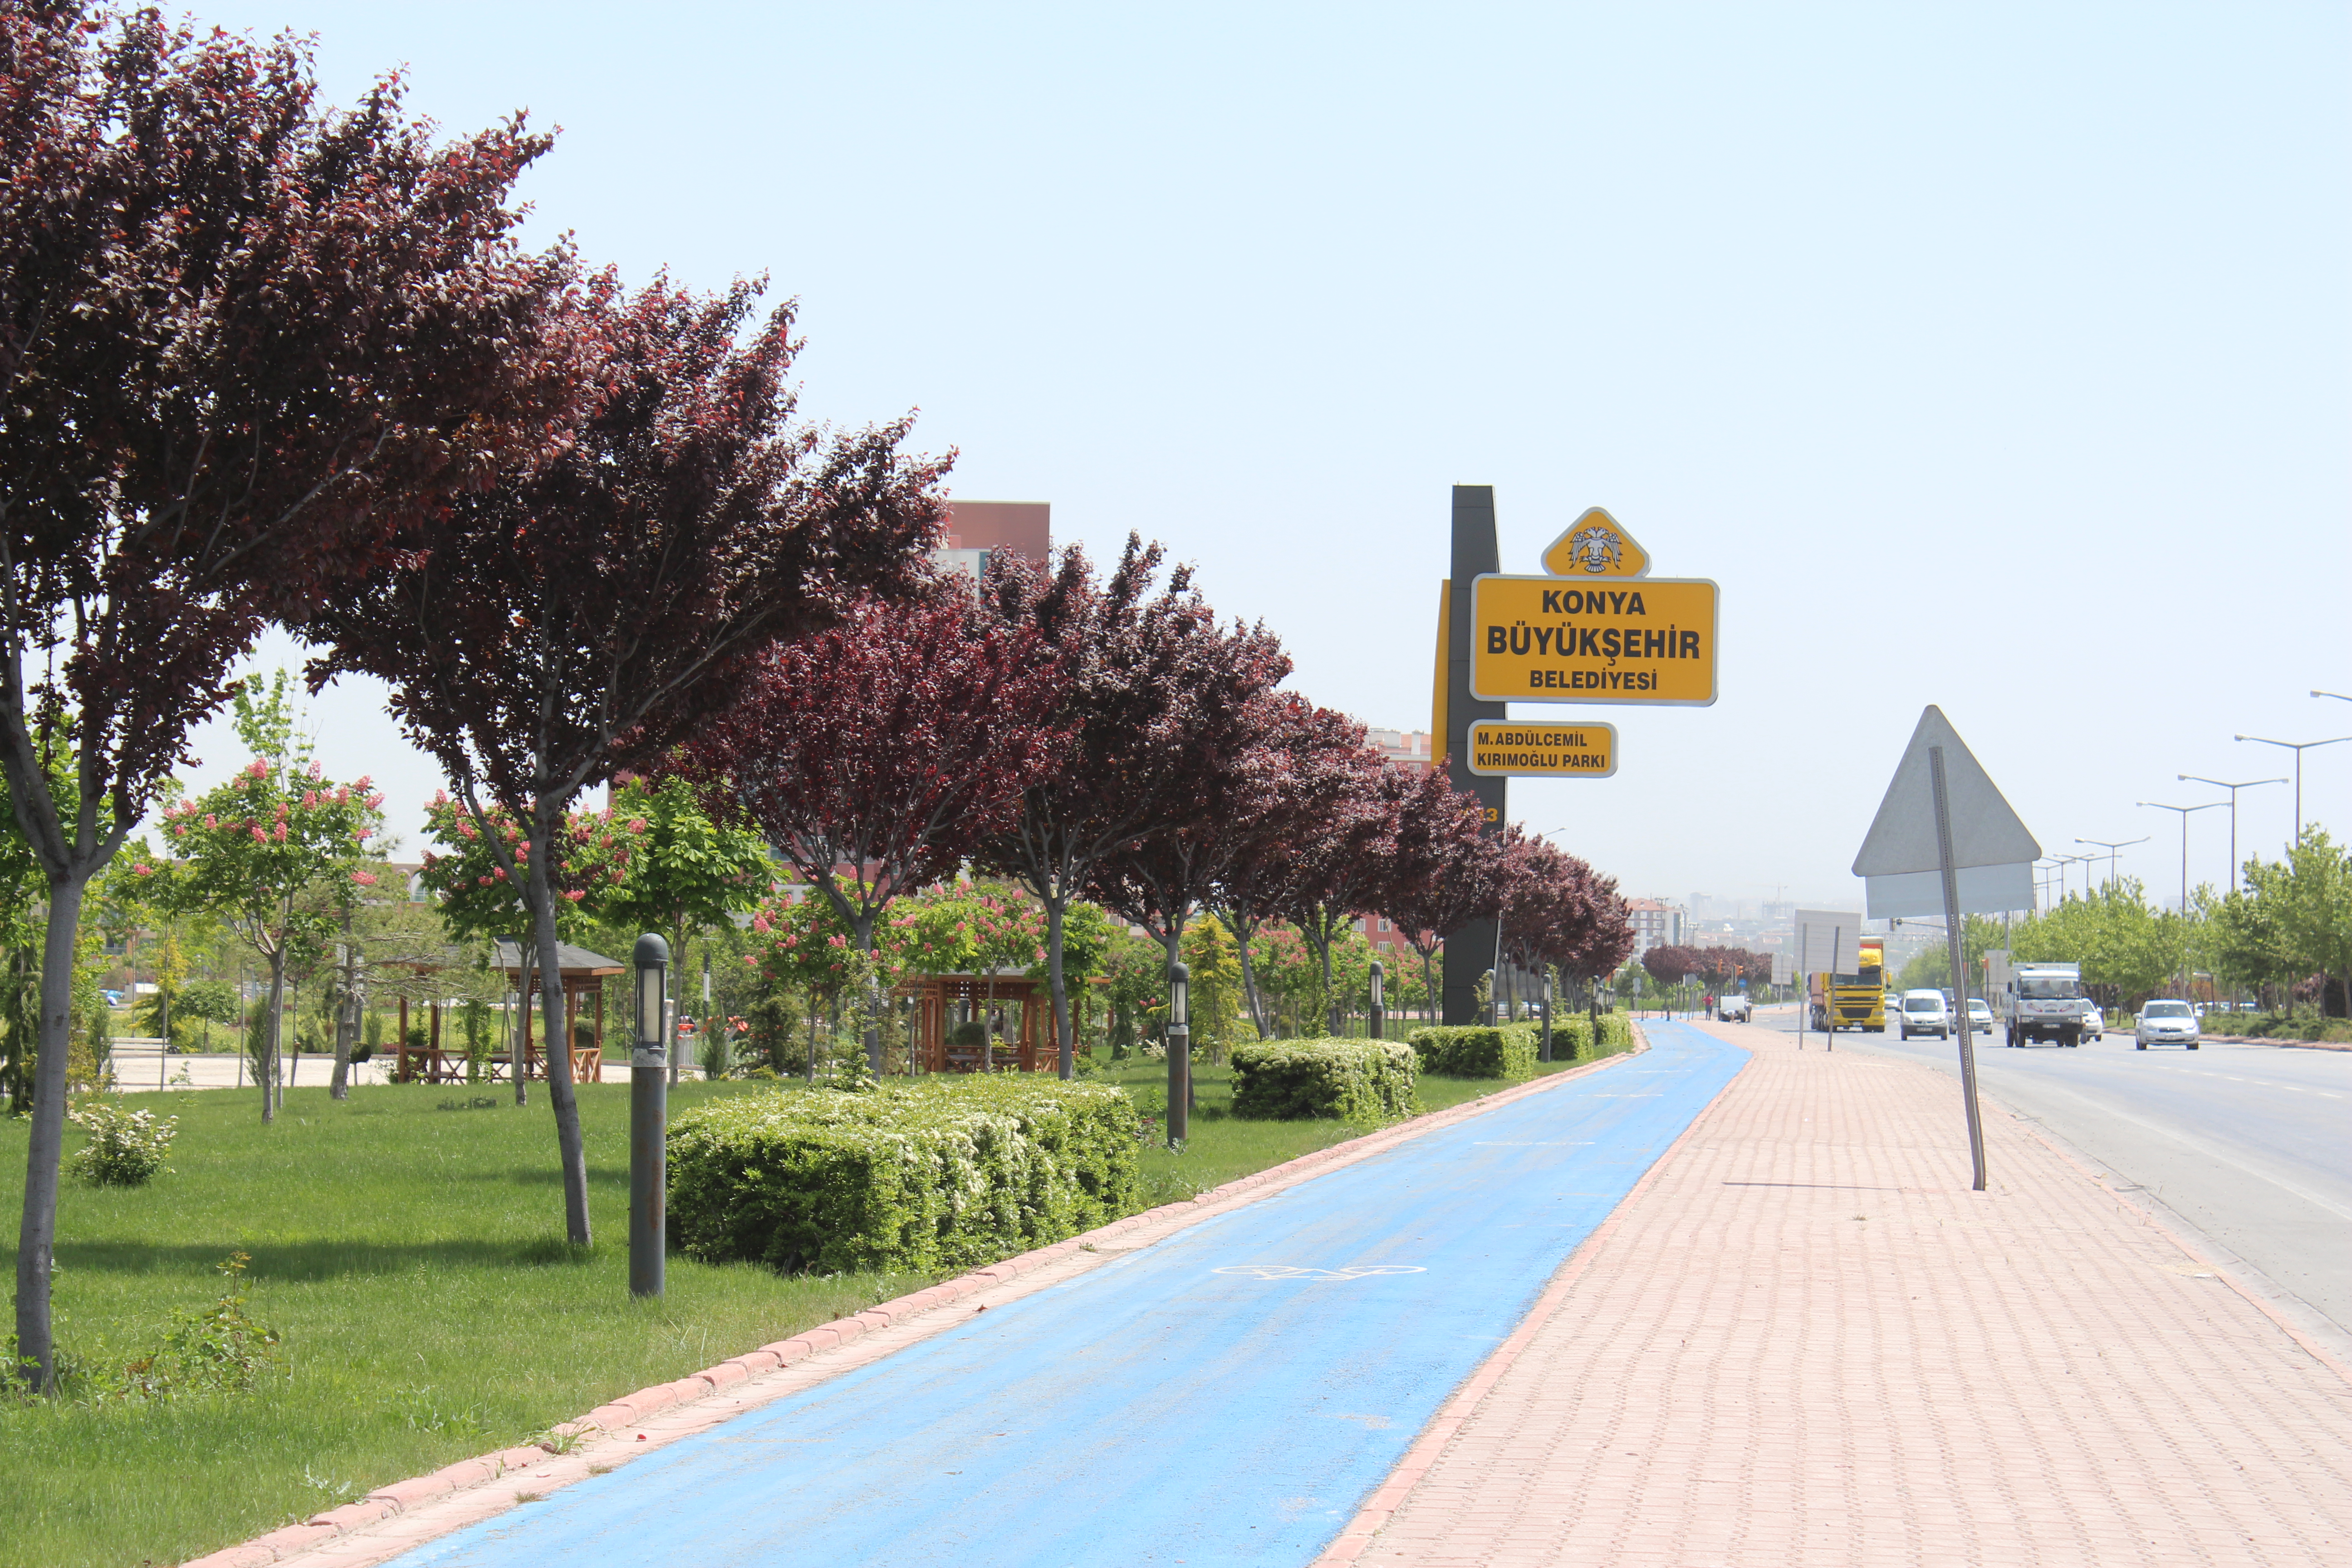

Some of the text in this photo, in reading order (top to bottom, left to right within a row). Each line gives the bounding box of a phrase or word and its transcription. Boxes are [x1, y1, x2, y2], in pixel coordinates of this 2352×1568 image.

[1542, 590, 1646, 615] KONYA
[1487, 621, 1700, 666] BÜYÜKŞEHİR
[1530, 667, 1657, 690] BELEDİYESİ
[1477, 750, 1604, 768] KIRIMOĞLU PARKI
